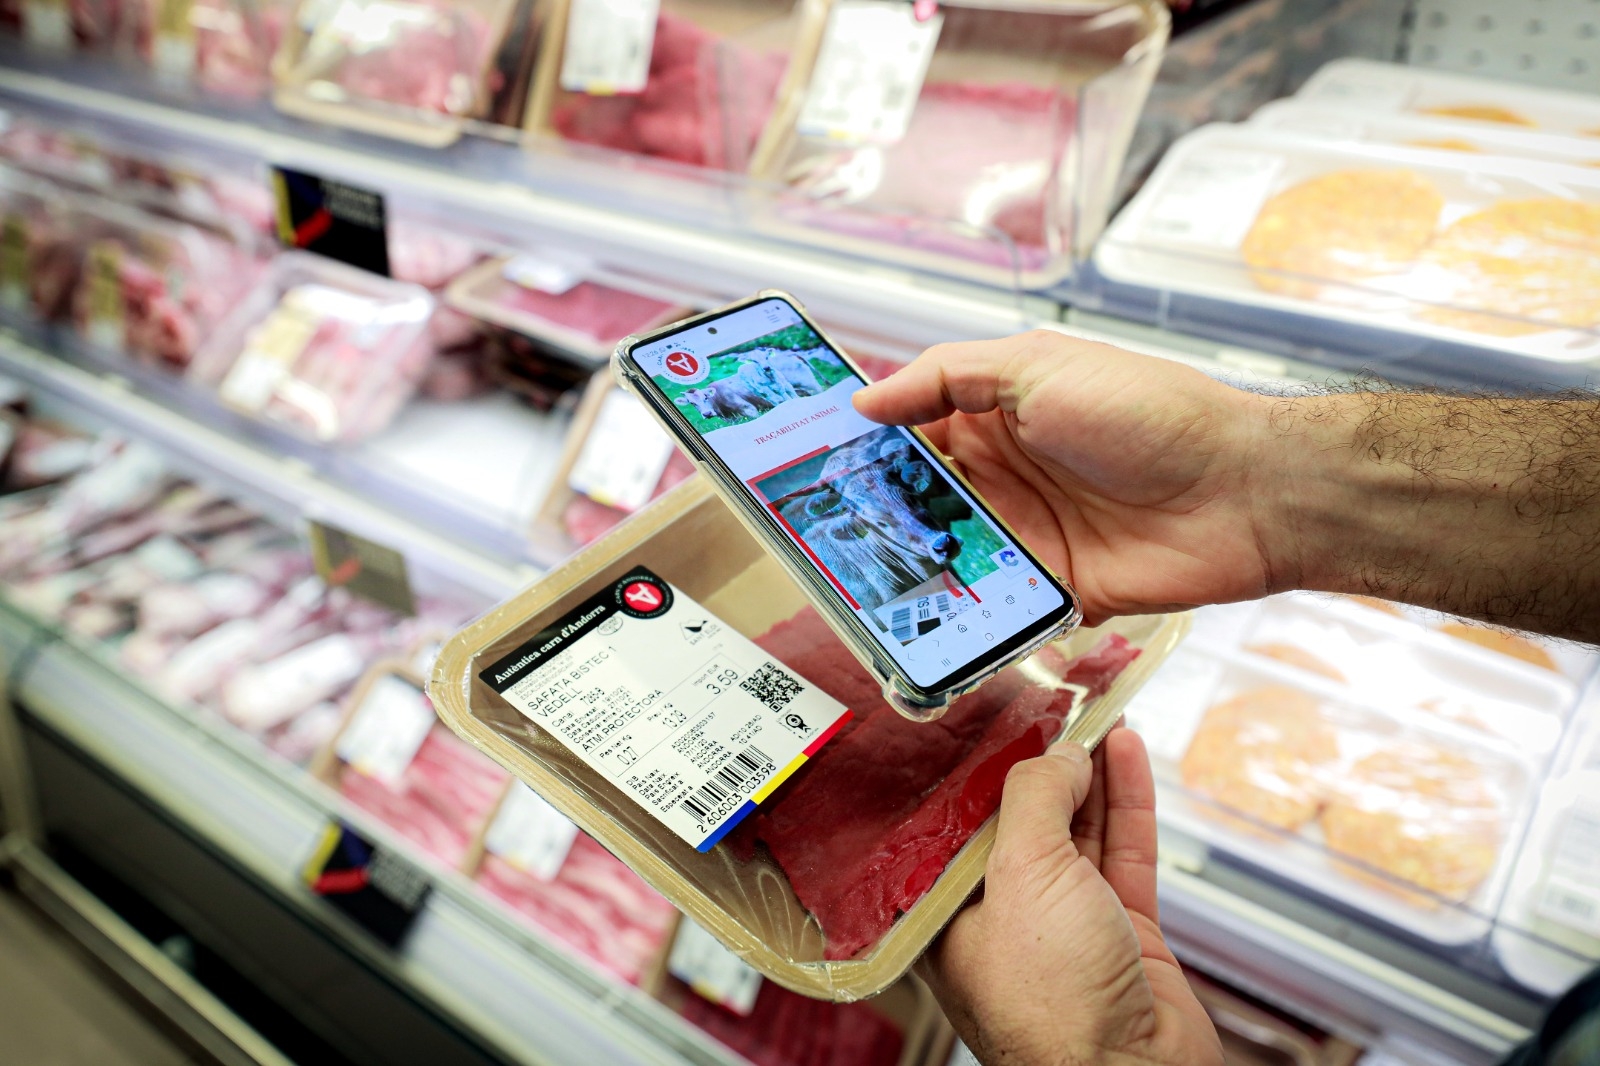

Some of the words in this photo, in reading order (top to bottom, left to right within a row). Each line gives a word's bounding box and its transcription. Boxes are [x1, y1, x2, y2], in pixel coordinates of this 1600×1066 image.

[754, 417, 809, 445] TRAÇABILITAT
[810, 405, 840, 422] ANIMAL
[495, 651, 541, 684] Autèntica
[540, 636, 562, 653] carn
[561, 605, 605, 638] d'Andorra
[527, 678, 572, 710] SAFATA
[569, 651, 609, 680] BISTEC
[706, 663, 719, 674] EUR
[706, 669, 739, 695] 3,59
[537, 688, 582, 717] VEDELL
[560, 722, 576, 734] Data
[601, 685, 625, 702] 19/10/21
[566, 727, 582, 739] Data
[607, 690, 631, 709] 27/10/21
[646, 712, 662, 721] Preu
[573, 722, 602, 744] Conservar
[602, 711, 617, 723] entre
[677, 730, 705, 754] ANDORRA
[599, 748, 613, 758] Pes
[610, 740, 623, 748] Net
[690, 740, 718, 764] ANDORRA
[704, 750, 733, 775] ANDORRA
[625, 775, 639, 786] DIB
[638, 783, 654, 795] Data
[683, 738, 708, 758] 17/11/20
[651, 783, 679, 805] Sacrificat
[696, 745, 725, 769] ANDORRA
[696, 824, 708, 833] 2
[706, 792, 743, 825] 606003
[740, 762, 777, 794] 003598
